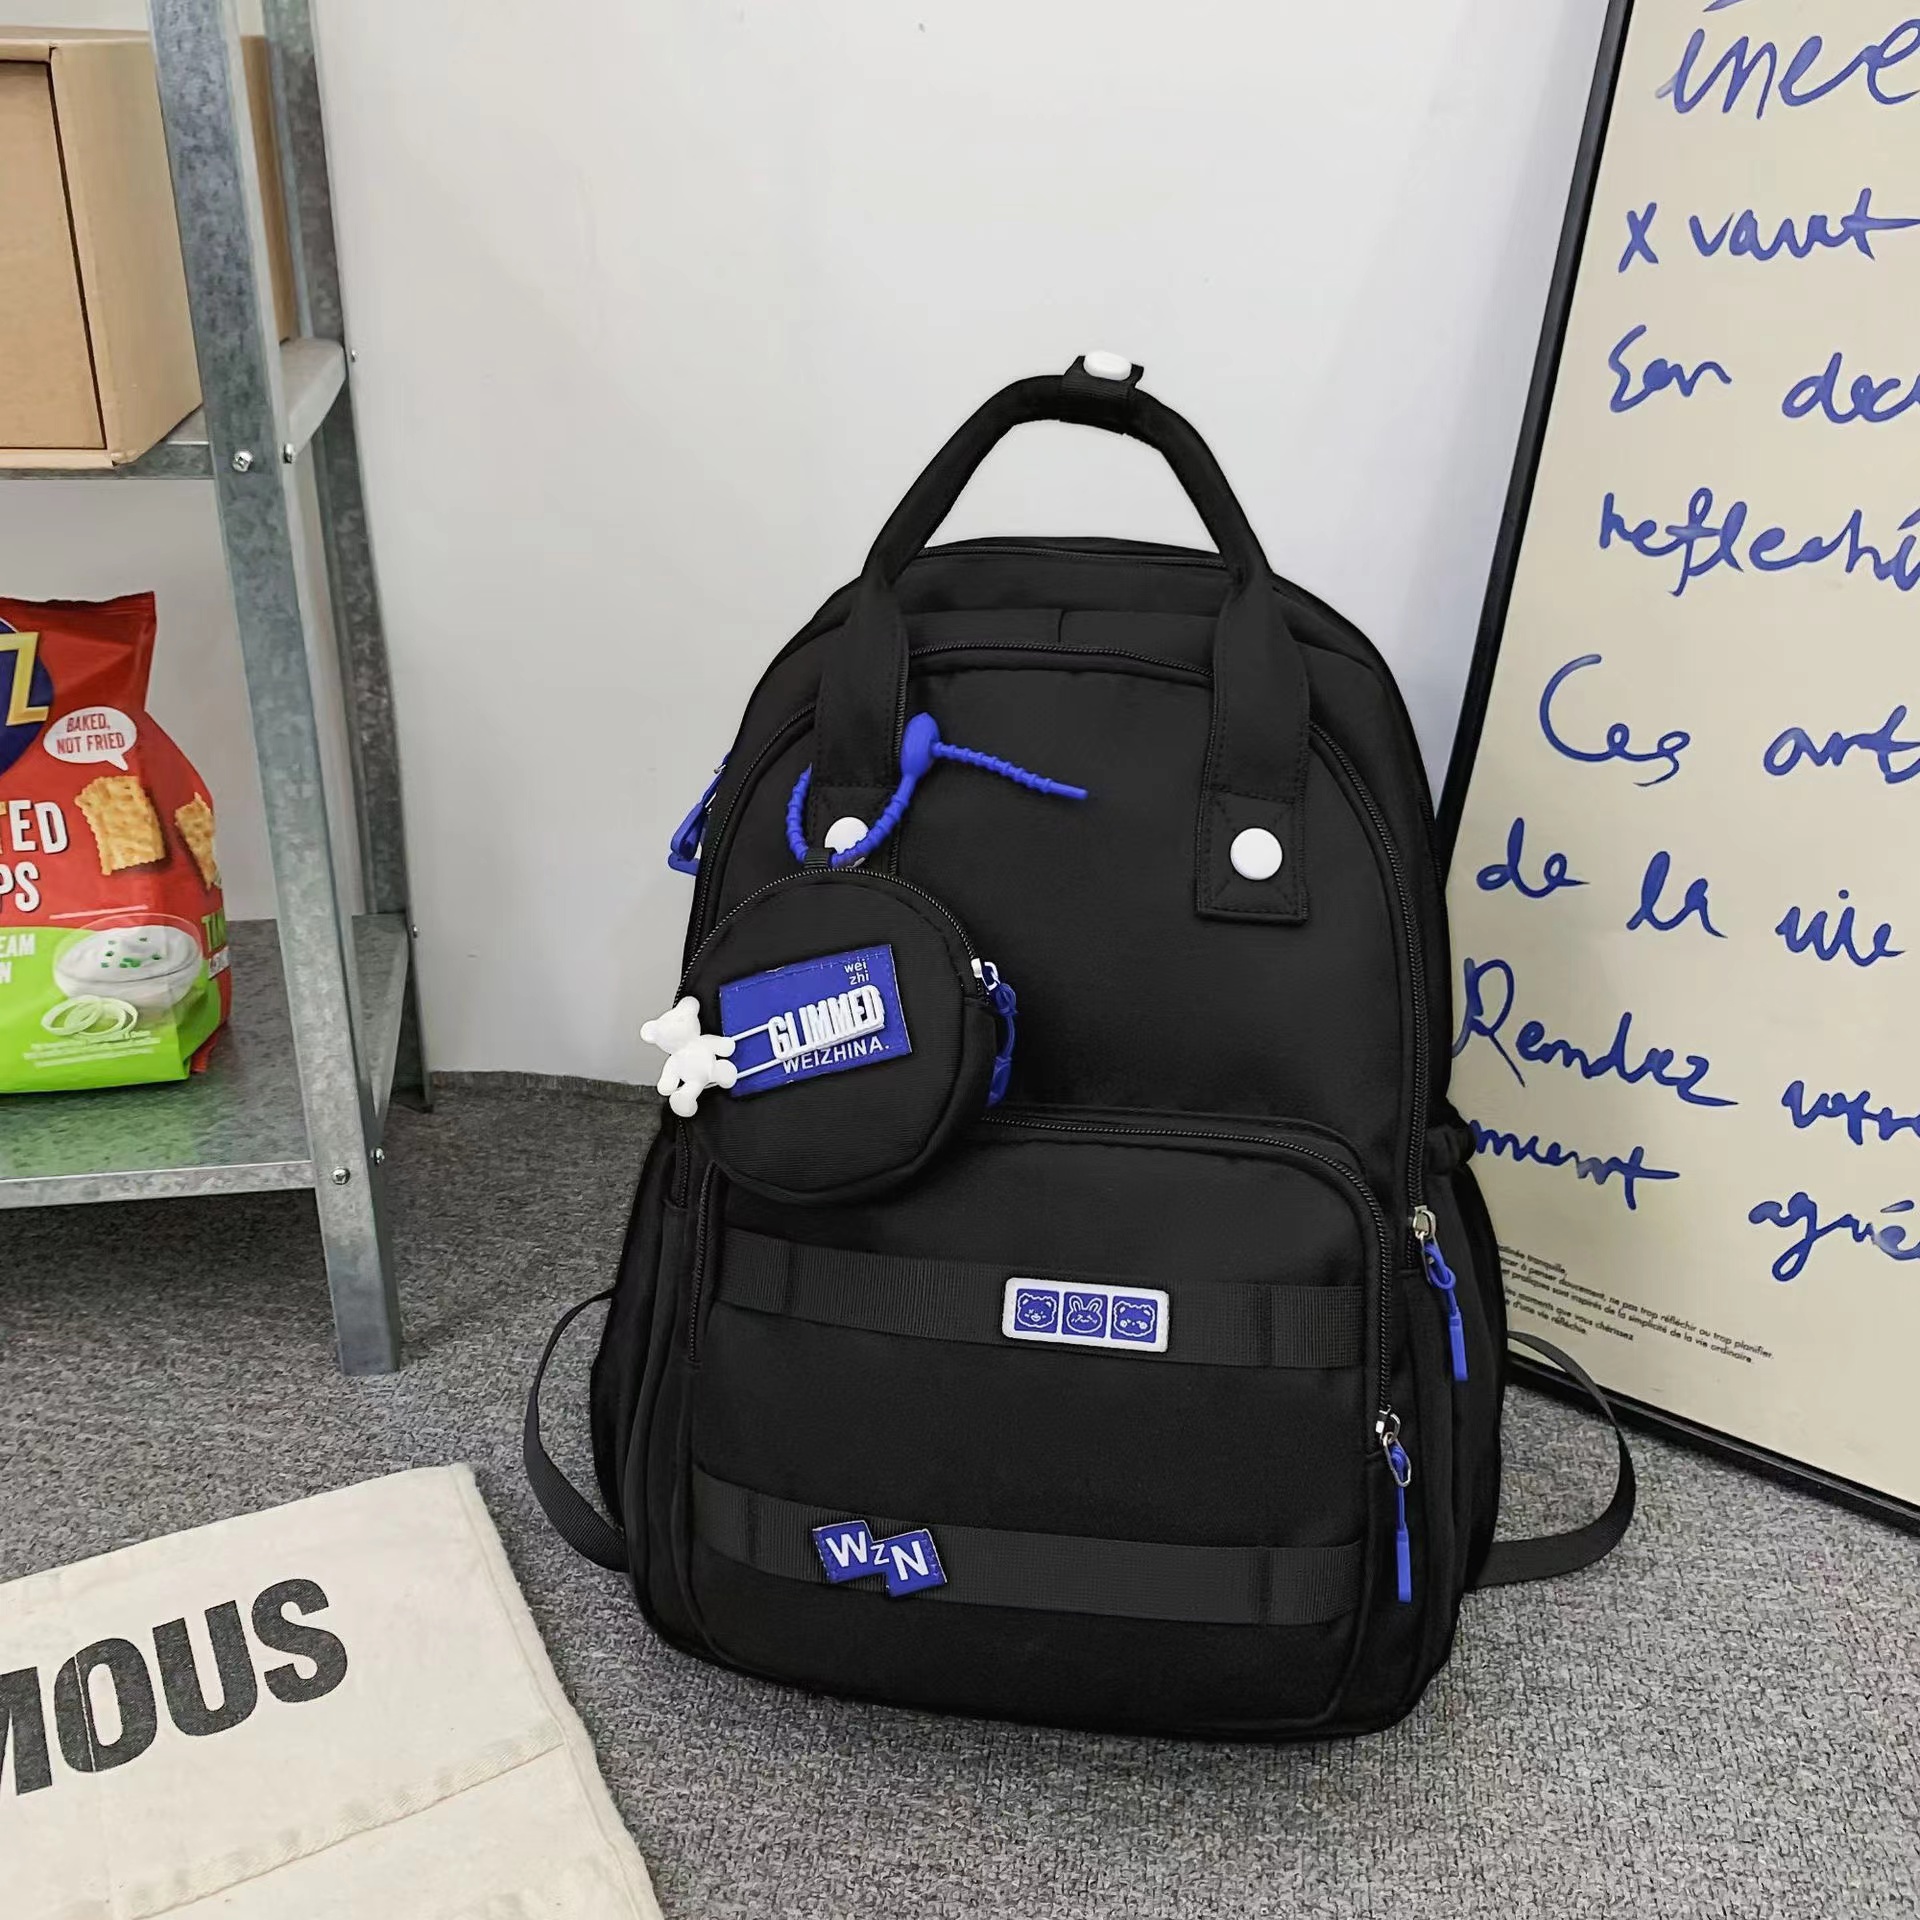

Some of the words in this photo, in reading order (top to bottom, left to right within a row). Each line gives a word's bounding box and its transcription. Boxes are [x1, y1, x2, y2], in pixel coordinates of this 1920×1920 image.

[66, 713, 111, 733] BAKED,
[56, 737, 82, 755] NOT
[86, 732, 126, 752] FRIED
[0, 799, 68, 854] ED
[844, 960, 867, 974] wei
[849, 970, 870, 986] zhi
